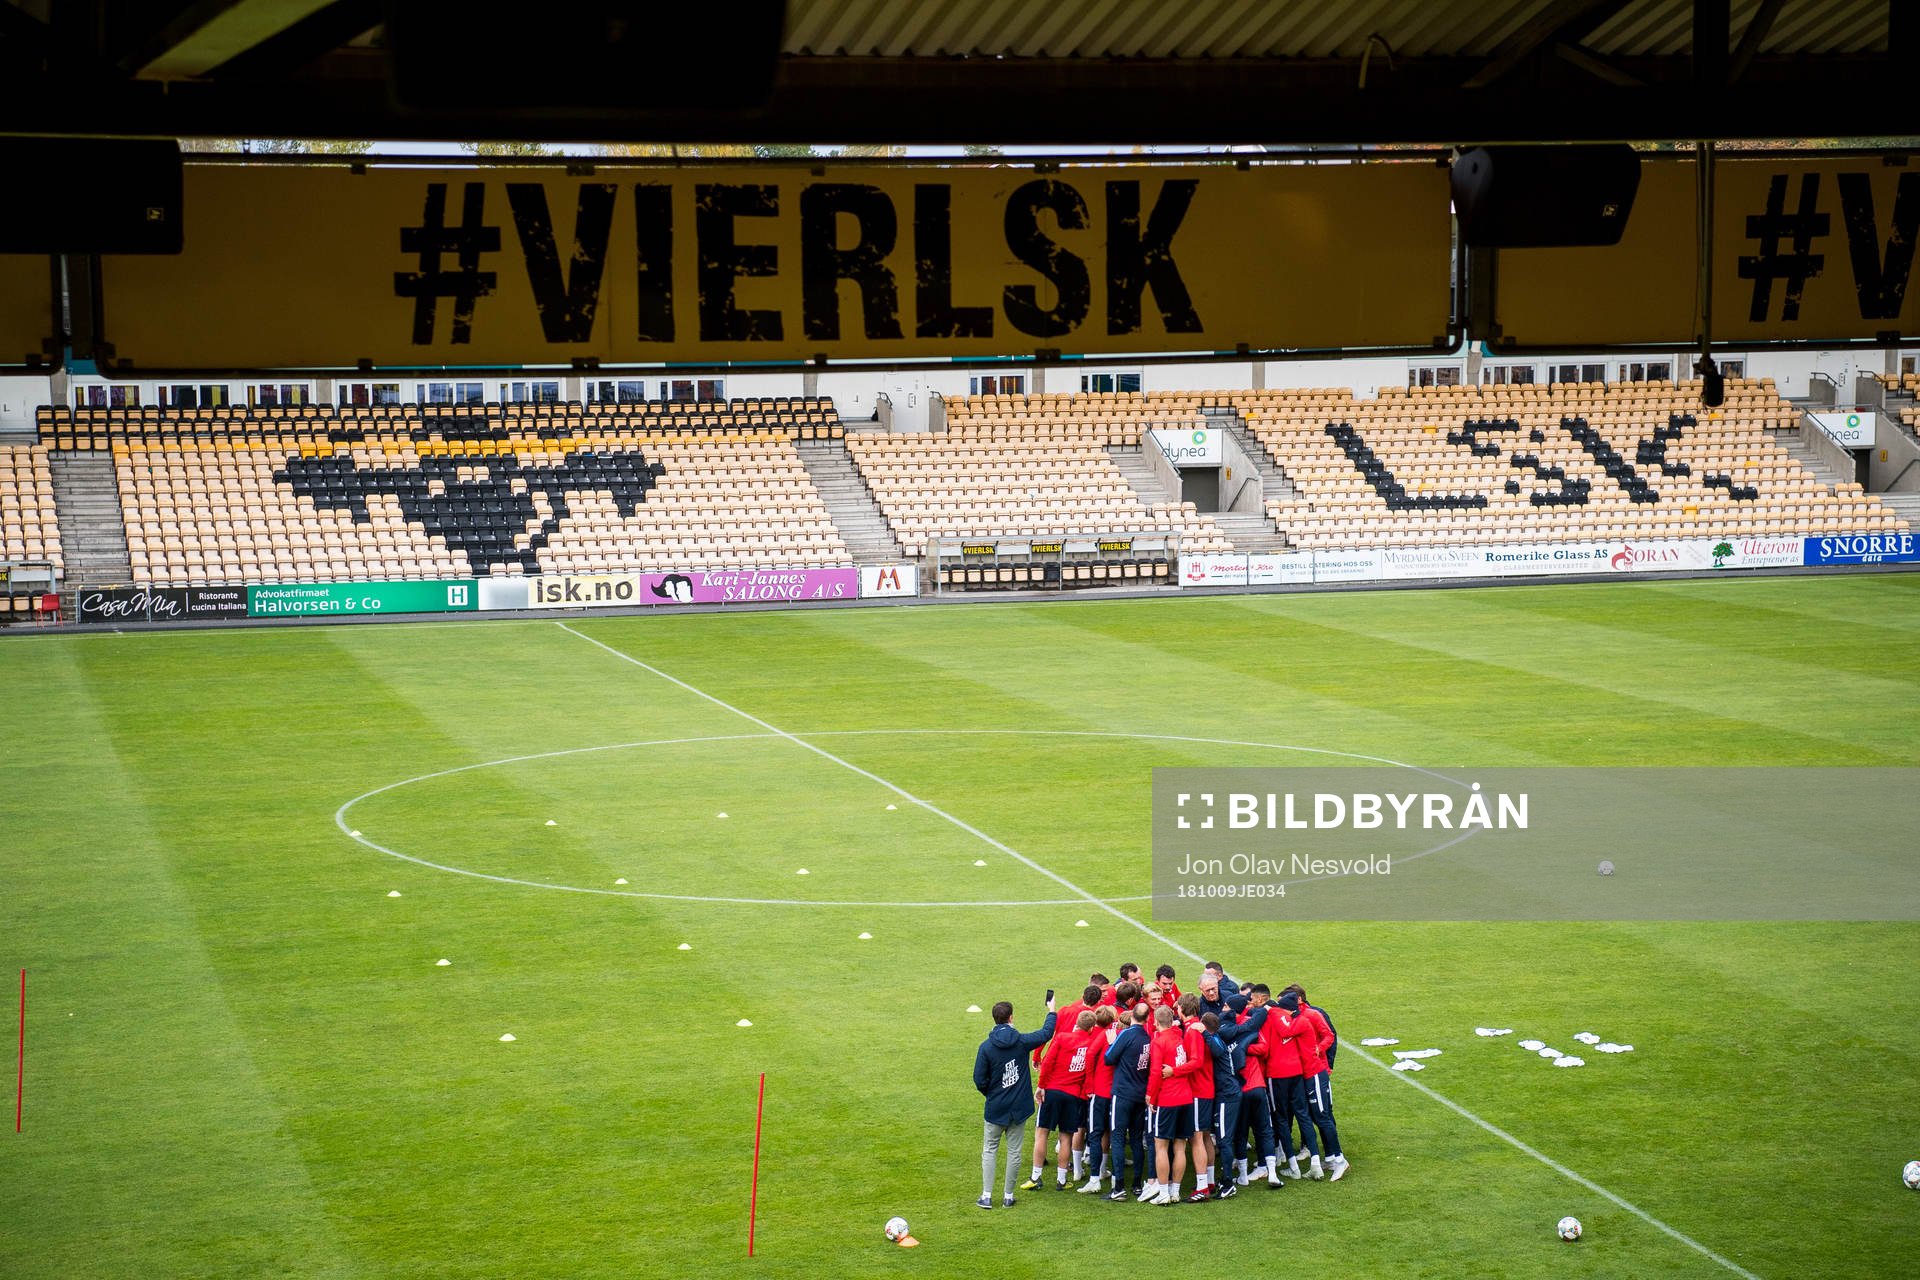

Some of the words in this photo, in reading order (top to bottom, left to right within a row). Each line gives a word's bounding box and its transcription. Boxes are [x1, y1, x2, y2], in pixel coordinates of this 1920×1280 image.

[394, 179, 1204, 345] #VIERLSK
[1161, 442, 1206, 463] dynea
[1100, 542, 1131, 551] #VIERLSK
[1740, 540, 1799, 555] Uterom
[1820, 536, 1914, 558] SNORRE
[1485, 551, 1550, 562] Romerike
[1553, 549, 1591, 560] Glass
[1593, 549, 1608, 559] AS
[1861, 553, 1883, 562] data
[1308, 561, 1342, 569] CATERING
[1343, 560, 1358, 568] HOS
[701, 571, 807, 587] Kari-Jannes
[198, 592, 239, 600] Ristorante
[255, 588, 330, 599] Advokatfirmaet
[722, 583, 803, 601] SALONG
[811, 583, 846, 598] A/S
[82, 593, 133, 617] Casa
[130, 592, 182, 616] Mia
[191, 603, 217, 611] cucina
[218, 602, 247, 610] Italiana
[255, 600, 340, 613] Halvorsen
[345, 598, 356, 609] &
[361, 597, 381, 609] Co
[1005, 1058, 1016, 1072] EAT
[1002, 1074, 1020, 1089] SLEEP
